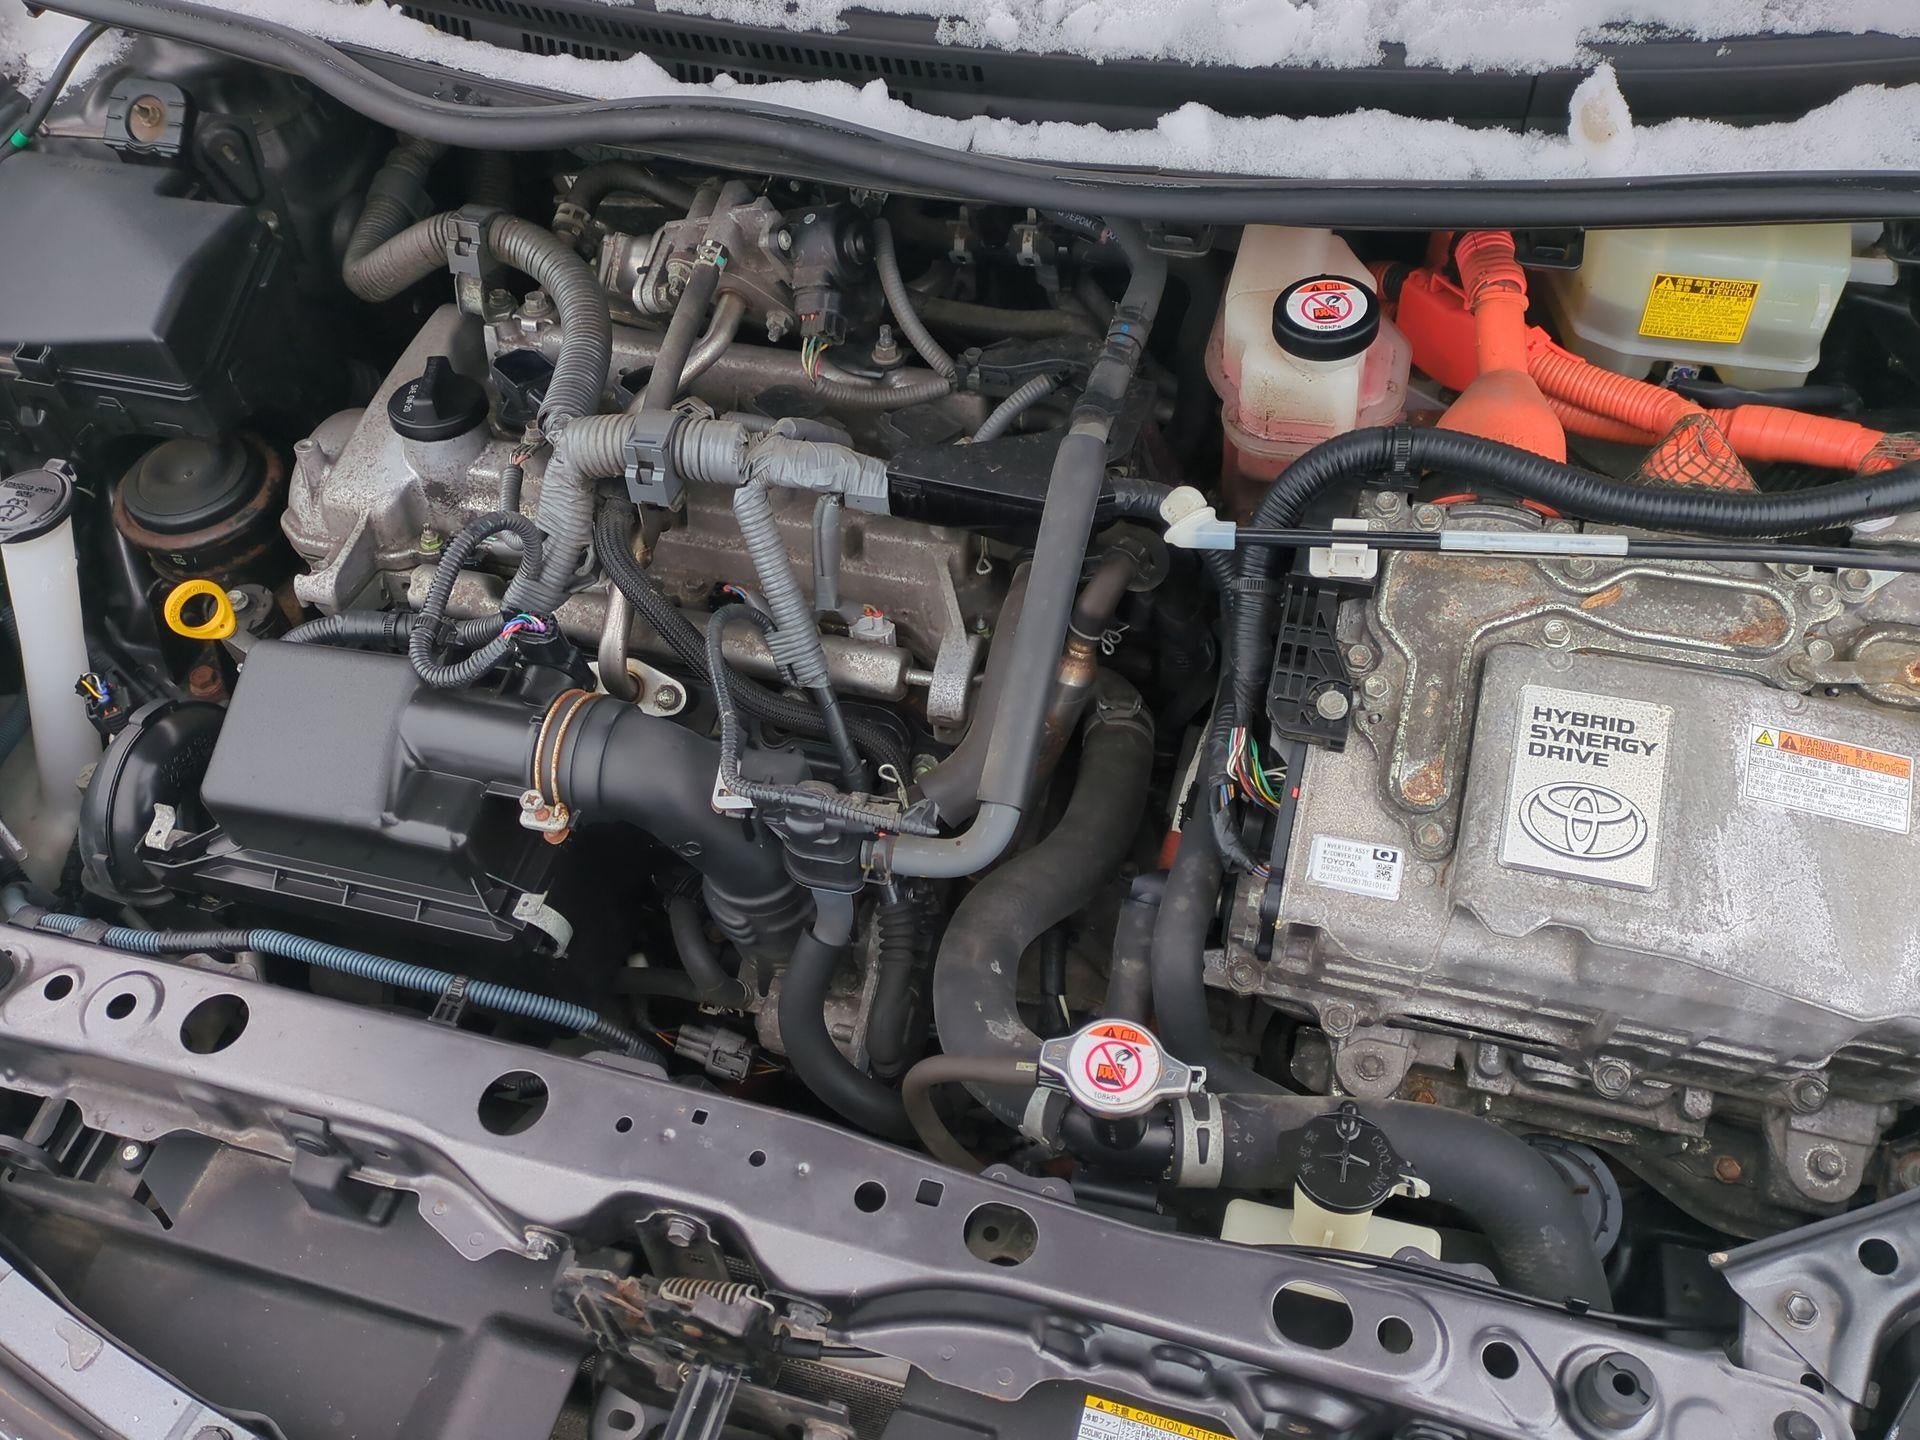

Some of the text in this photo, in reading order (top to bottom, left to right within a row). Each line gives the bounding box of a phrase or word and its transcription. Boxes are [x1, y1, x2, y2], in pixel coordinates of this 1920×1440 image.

[1699, 287, 1752, 297] ATTENTION
[1712, 281, 1754, 291] CAUTION
[1533, 706, 1635, 735] HYBRID
[1530, 724, 1659, 757] SYNERGY
[1800, 738, 1840, 753] WARNING
[1528, 742, 1610, 768] DRIVE
[1799, 746, 1849, 764] AVERTISSEMENT
[1324, 842, 1352, 852] INVERTER
[1322, 856, 1356, 868] TOYOTA
[1094, 1092, 1121, 1103] 108kPa
[1110, 1404, 1130, 1418] 注意
[1135, 1411, 1182, 1433] CAUTION
